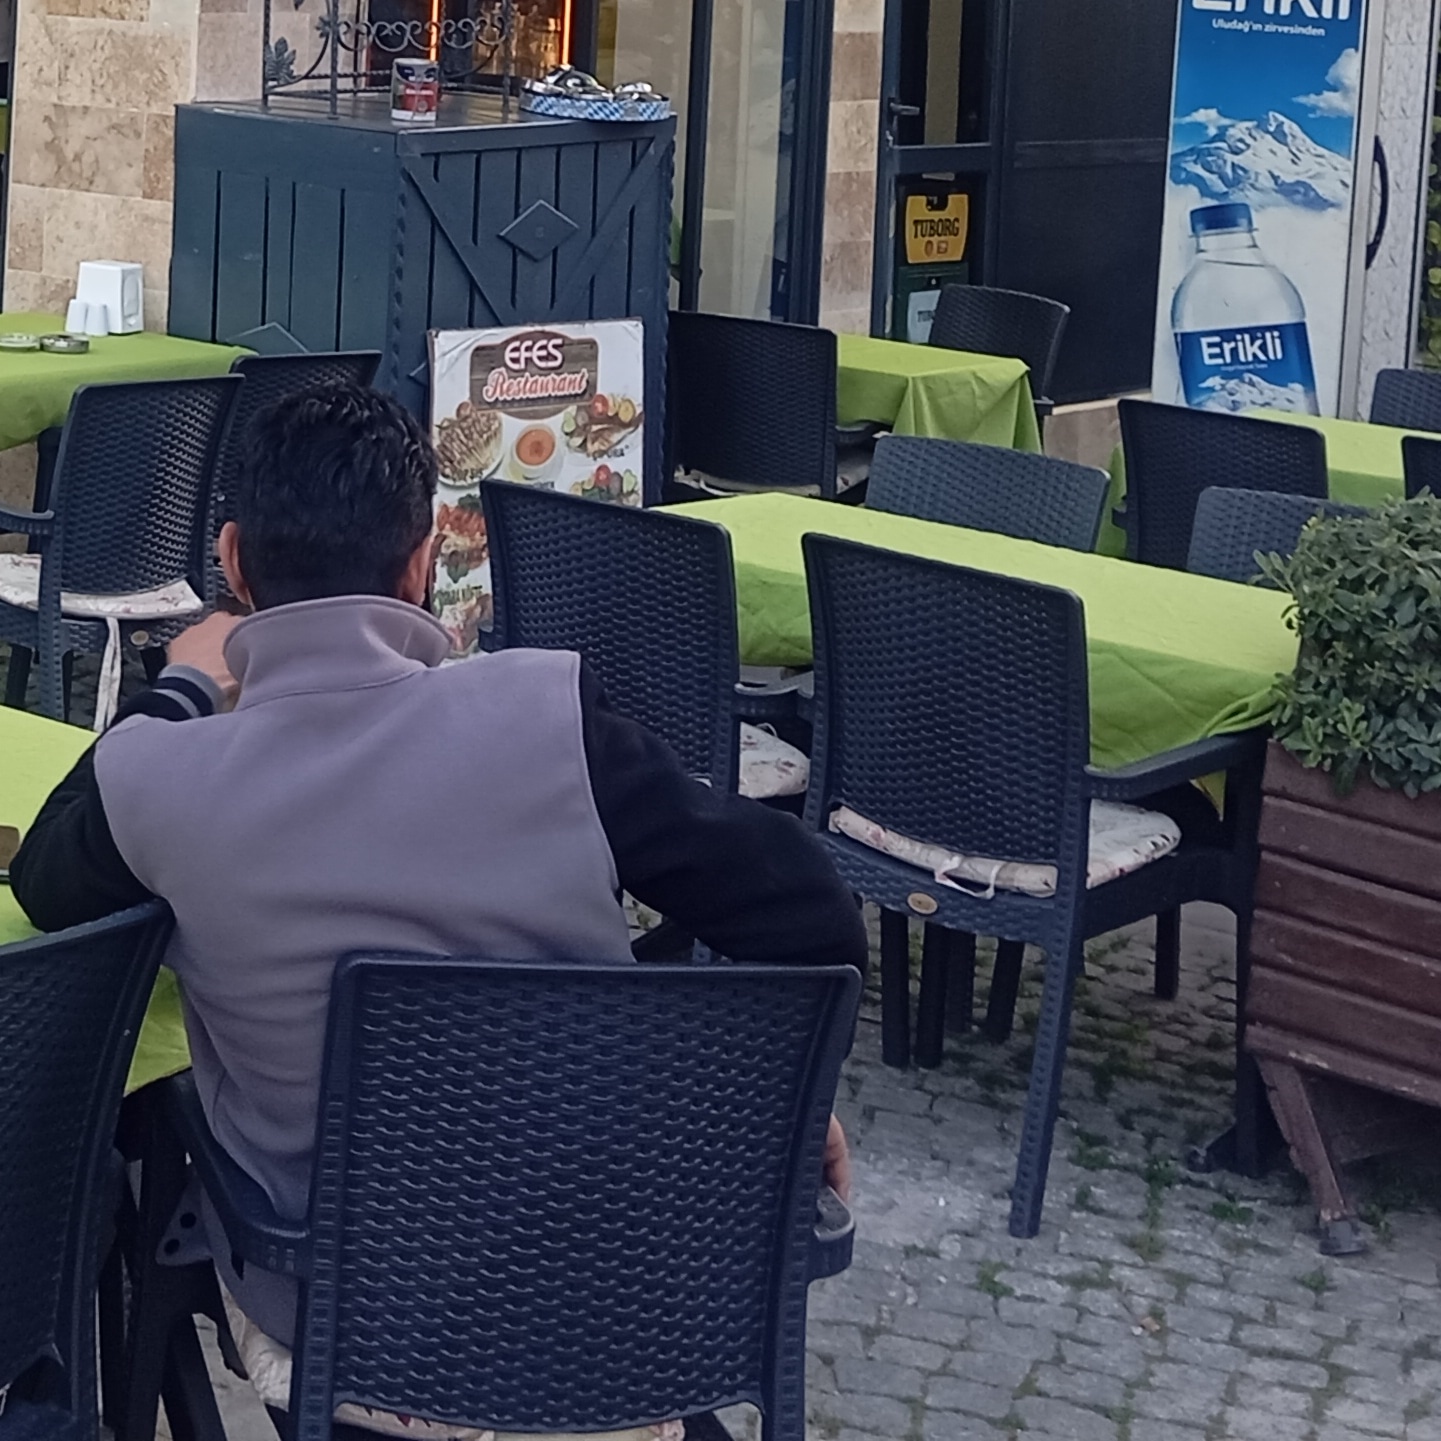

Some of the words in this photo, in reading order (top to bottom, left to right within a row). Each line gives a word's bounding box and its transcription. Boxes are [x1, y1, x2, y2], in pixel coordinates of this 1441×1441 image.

[1264, 23, 1326, 37] zirvesinden
[913, 217, 960, 239] TUBORG
[504, 339, 564, 371] EFES
[1200, 331, 1283, 366] Erikli
[483, 367, 589, 402] Restaurant
